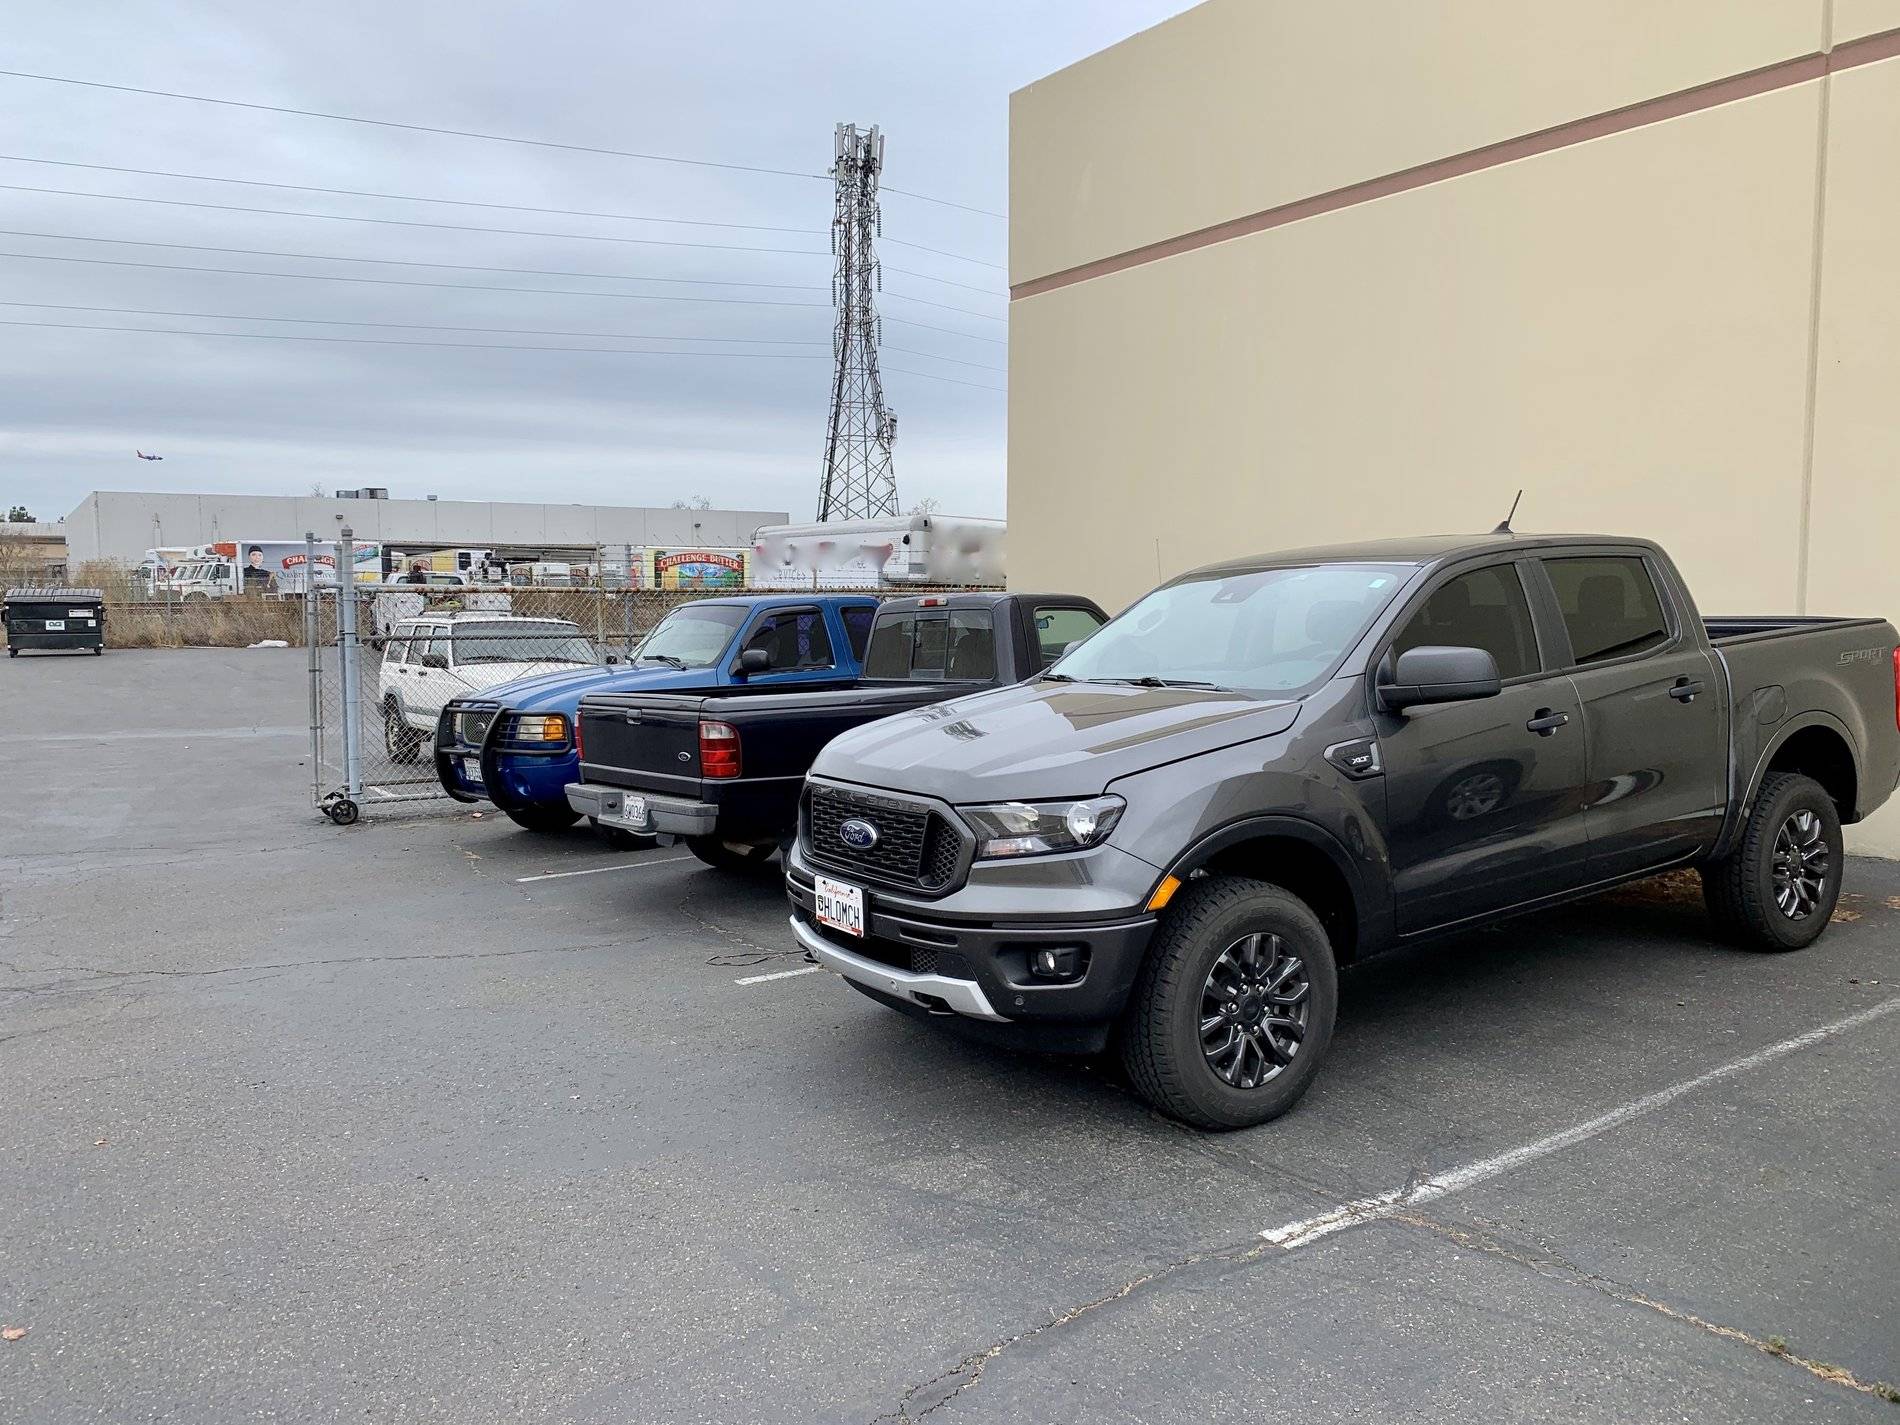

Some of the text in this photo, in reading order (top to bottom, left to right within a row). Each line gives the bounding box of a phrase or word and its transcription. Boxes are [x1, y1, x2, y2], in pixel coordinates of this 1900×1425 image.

[286, 555, 335, 566] CHALNGE
[660, 553, 739, 569] CHALLENGE BUTTER
